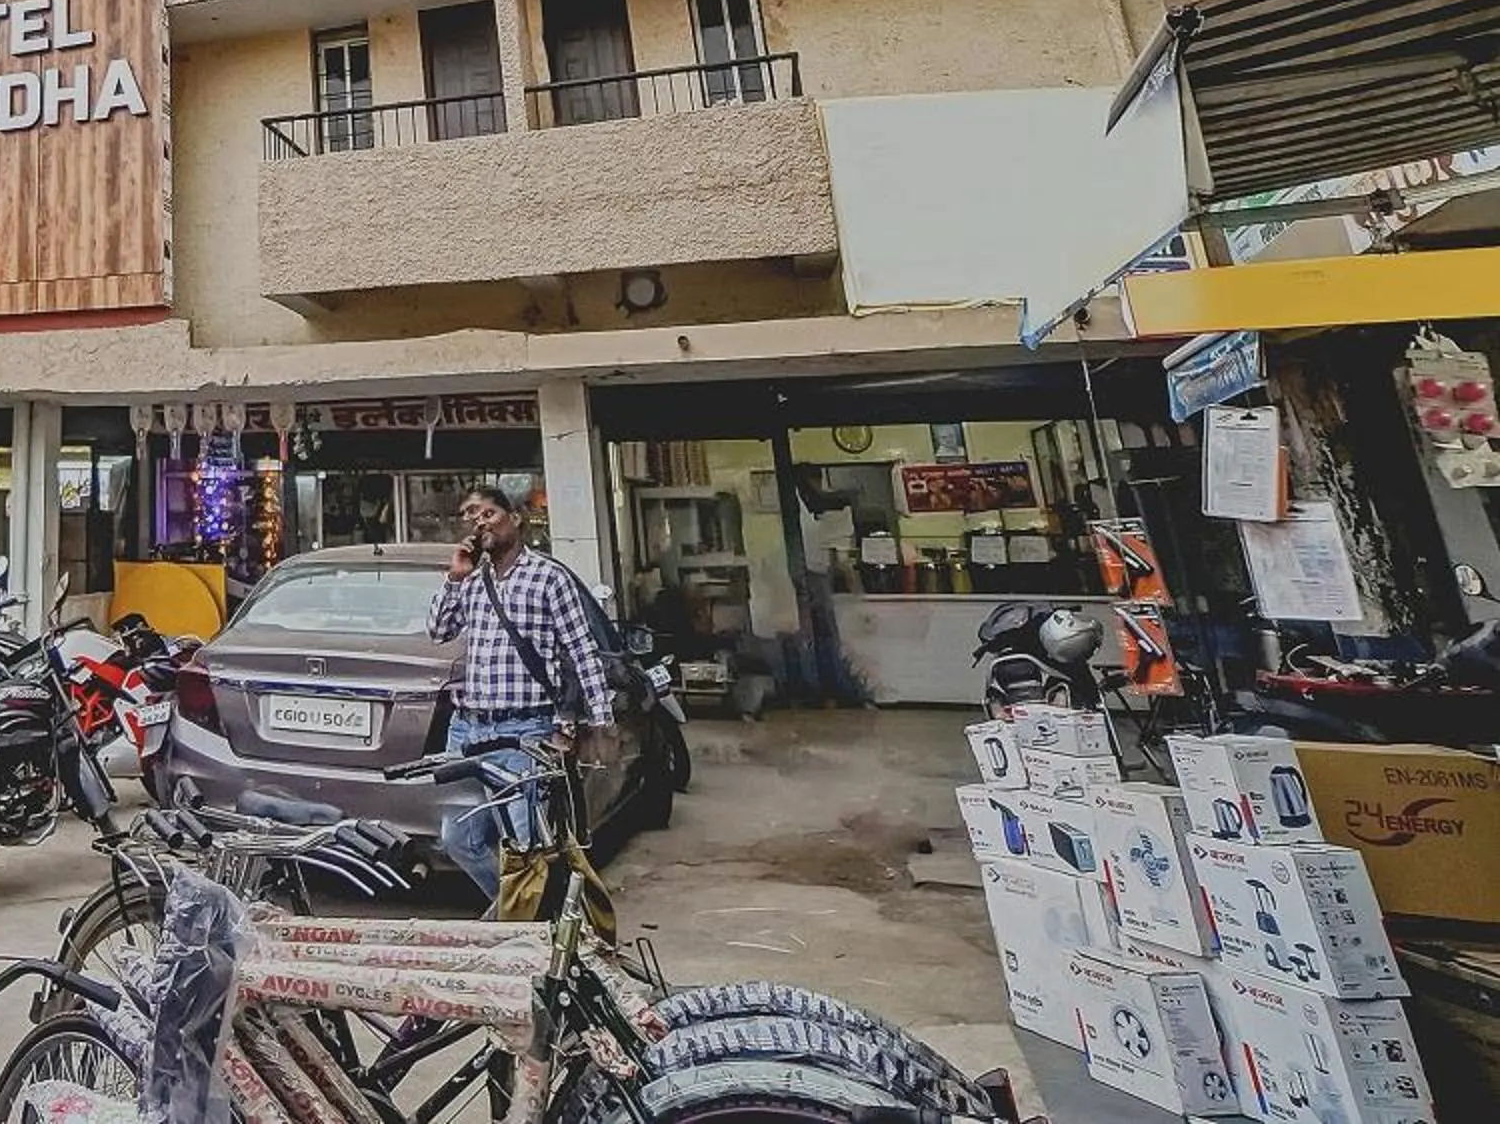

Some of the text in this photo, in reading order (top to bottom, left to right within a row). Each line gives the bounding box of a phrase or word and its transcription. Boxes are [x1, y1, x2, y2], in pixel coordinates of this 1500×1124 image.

[261, 975, 329, 998] AVON
[335, 982, 393, 1003] CYCLES
[401, 995, 473, 1018] AVON
